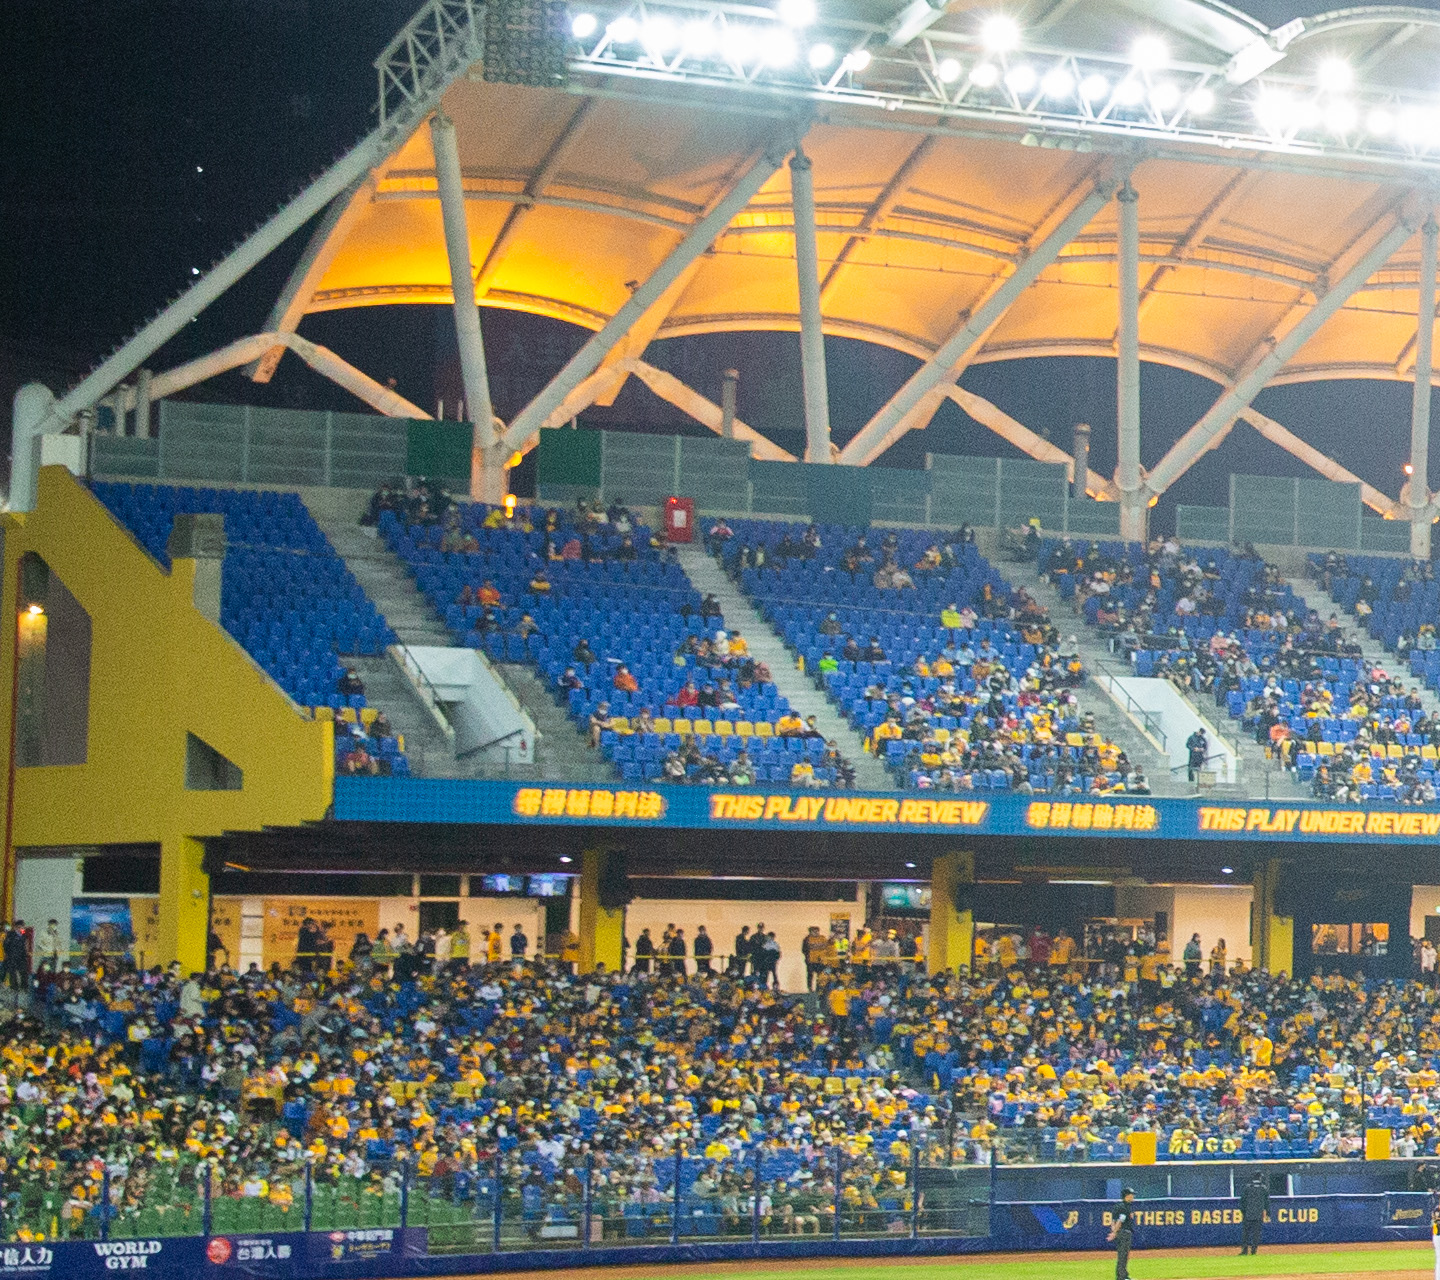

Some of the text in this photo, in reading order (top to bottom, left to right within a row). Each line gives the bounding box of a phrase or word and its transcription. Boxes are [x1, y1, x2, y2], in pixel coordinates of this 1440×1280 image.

[711, 794, 989, 825] THIS PLAY UNDER REVIEW
[1200, 807, 1247, 831] THIS
[1247, 809, 1299, 832] PLAY
[1300, 811, 1366, 834] UNDER
[1102, 1210, 1185, 1226] BTHERS
[1278, 1208, 1319, 1223] CLUB
[94, 1241, 163, 1256] WORLD
[105, 1255, 148, 1270] GYM
